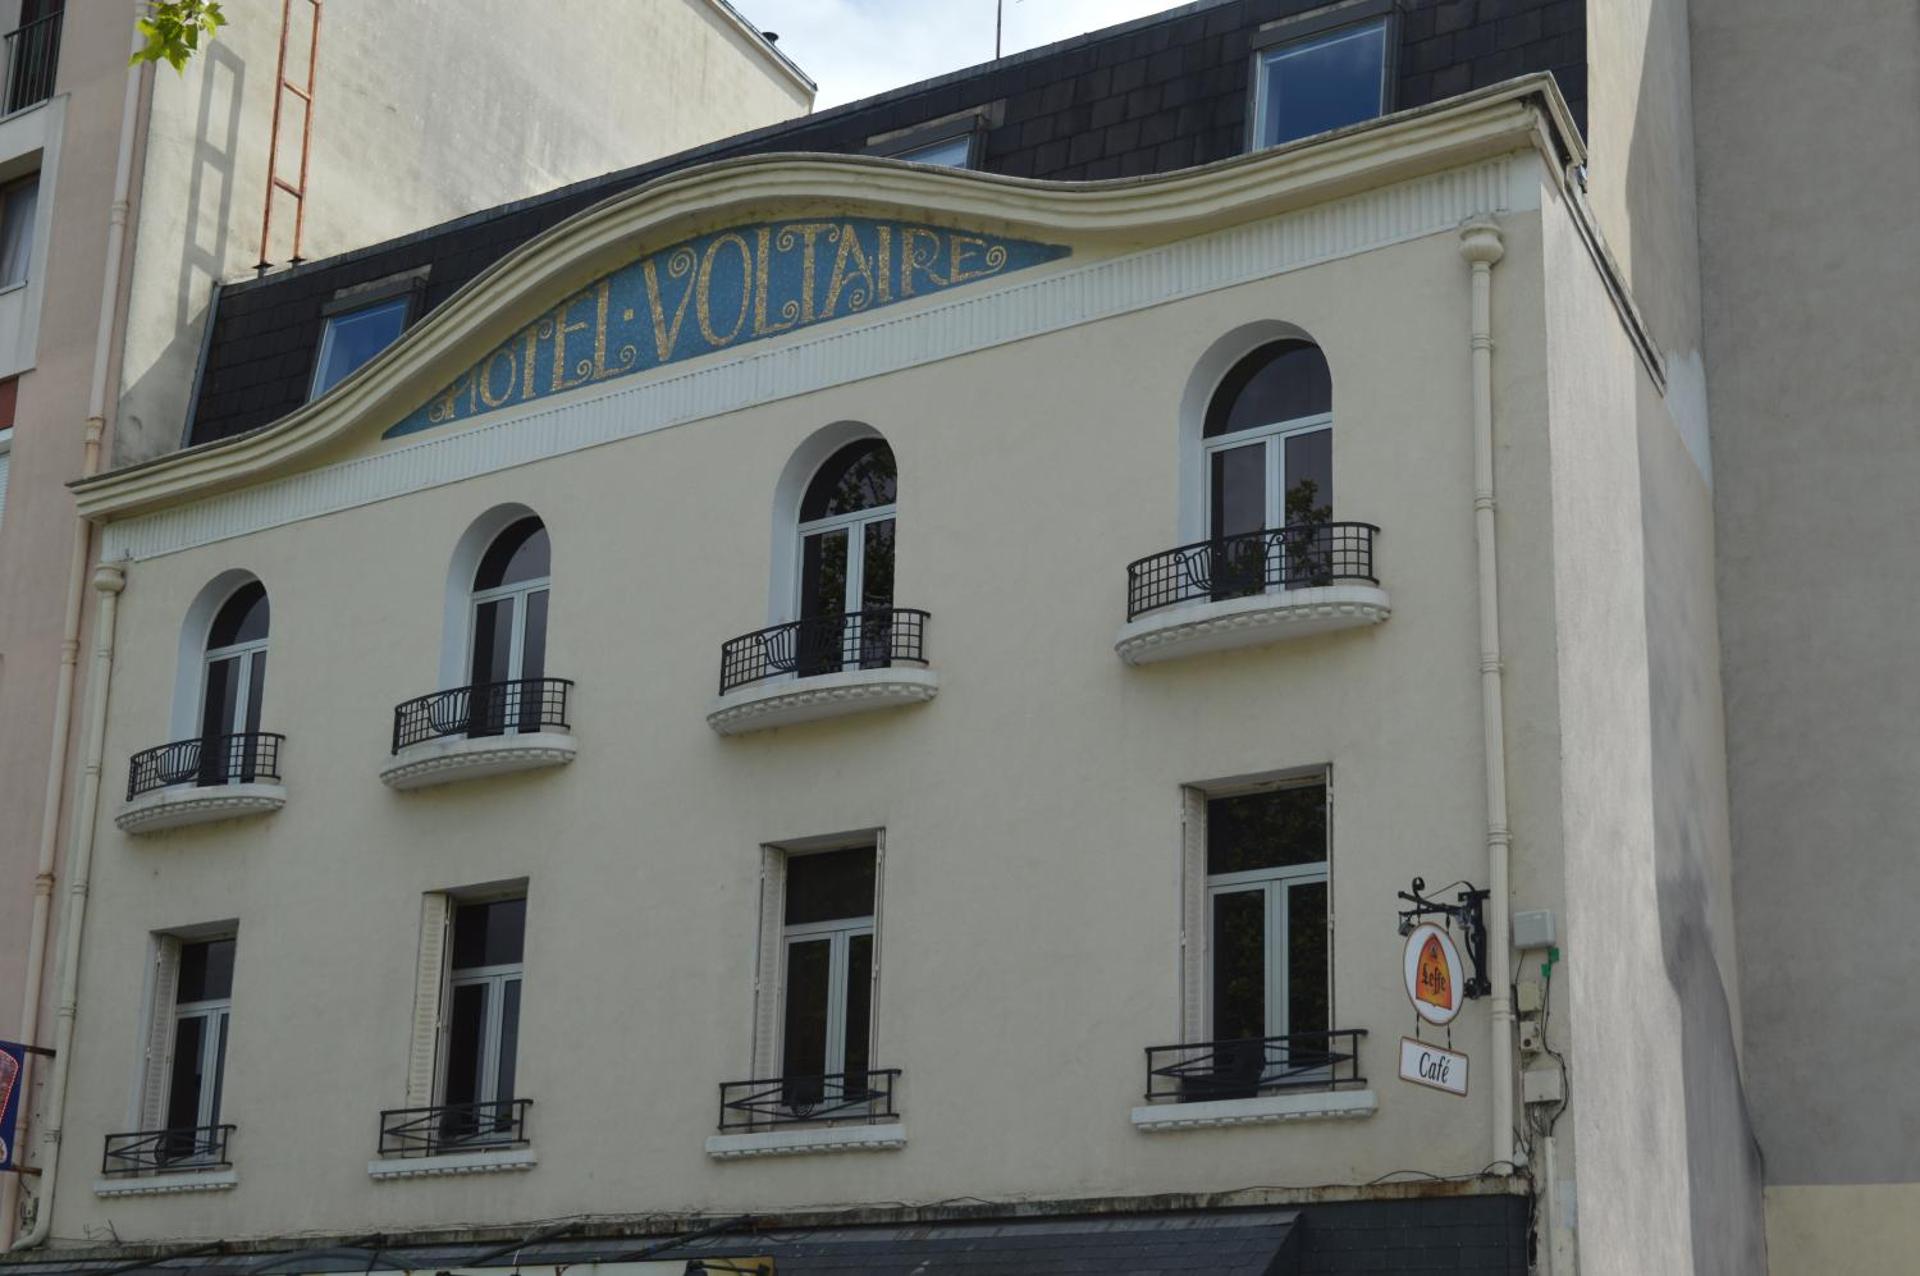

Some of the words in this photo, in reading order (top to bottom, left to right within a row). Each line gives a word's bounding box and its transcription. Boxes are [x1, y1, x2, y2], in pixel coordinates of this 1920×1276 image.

[643, 223, 1007, 362] VOLTAIRE
[1422, 963, 1447, 995] Leffe
[1419, 1052, 1450, 1083] Café
